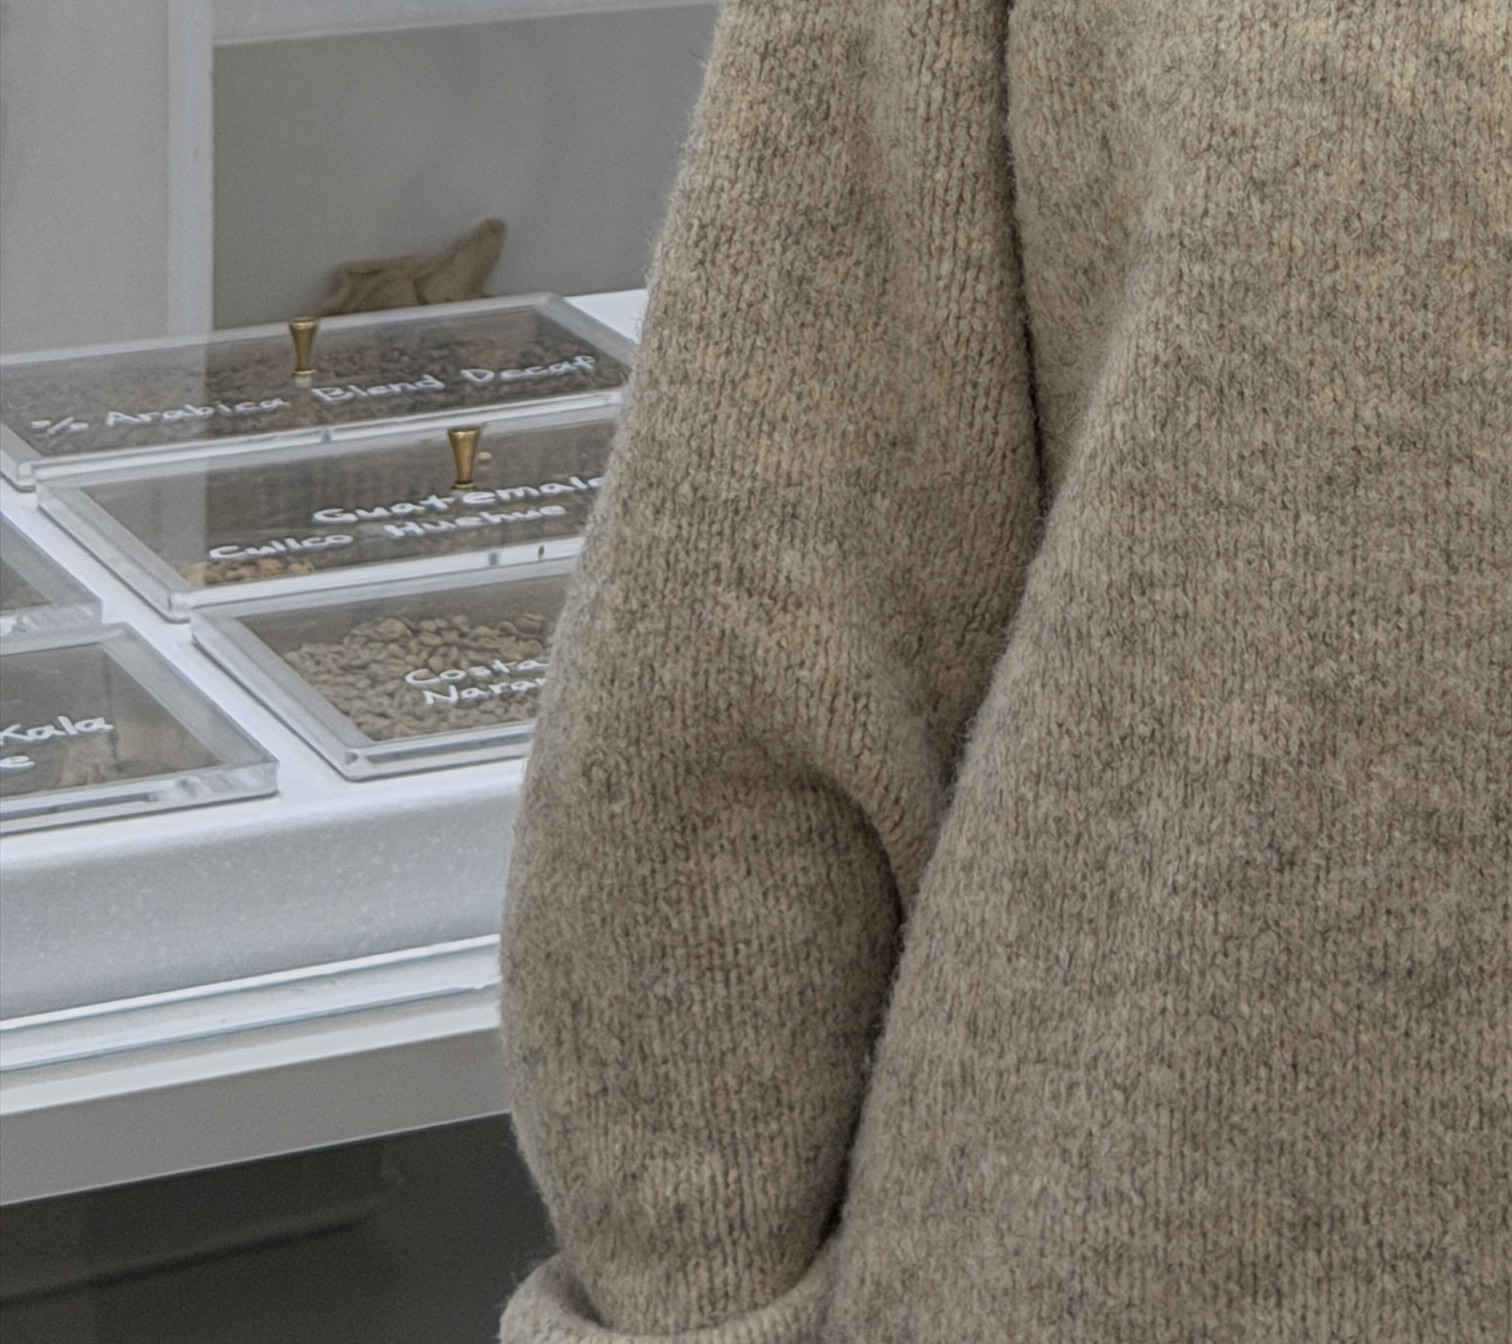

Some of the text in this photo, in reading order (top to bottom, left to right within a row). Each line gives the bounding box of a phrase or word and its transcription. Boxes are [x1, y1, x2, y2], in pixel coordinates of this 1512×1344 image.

[105, 396, 291, 429] Arabica
[310, 372, 446, 405] Blend
[404, 658, 551, 687] Costa
